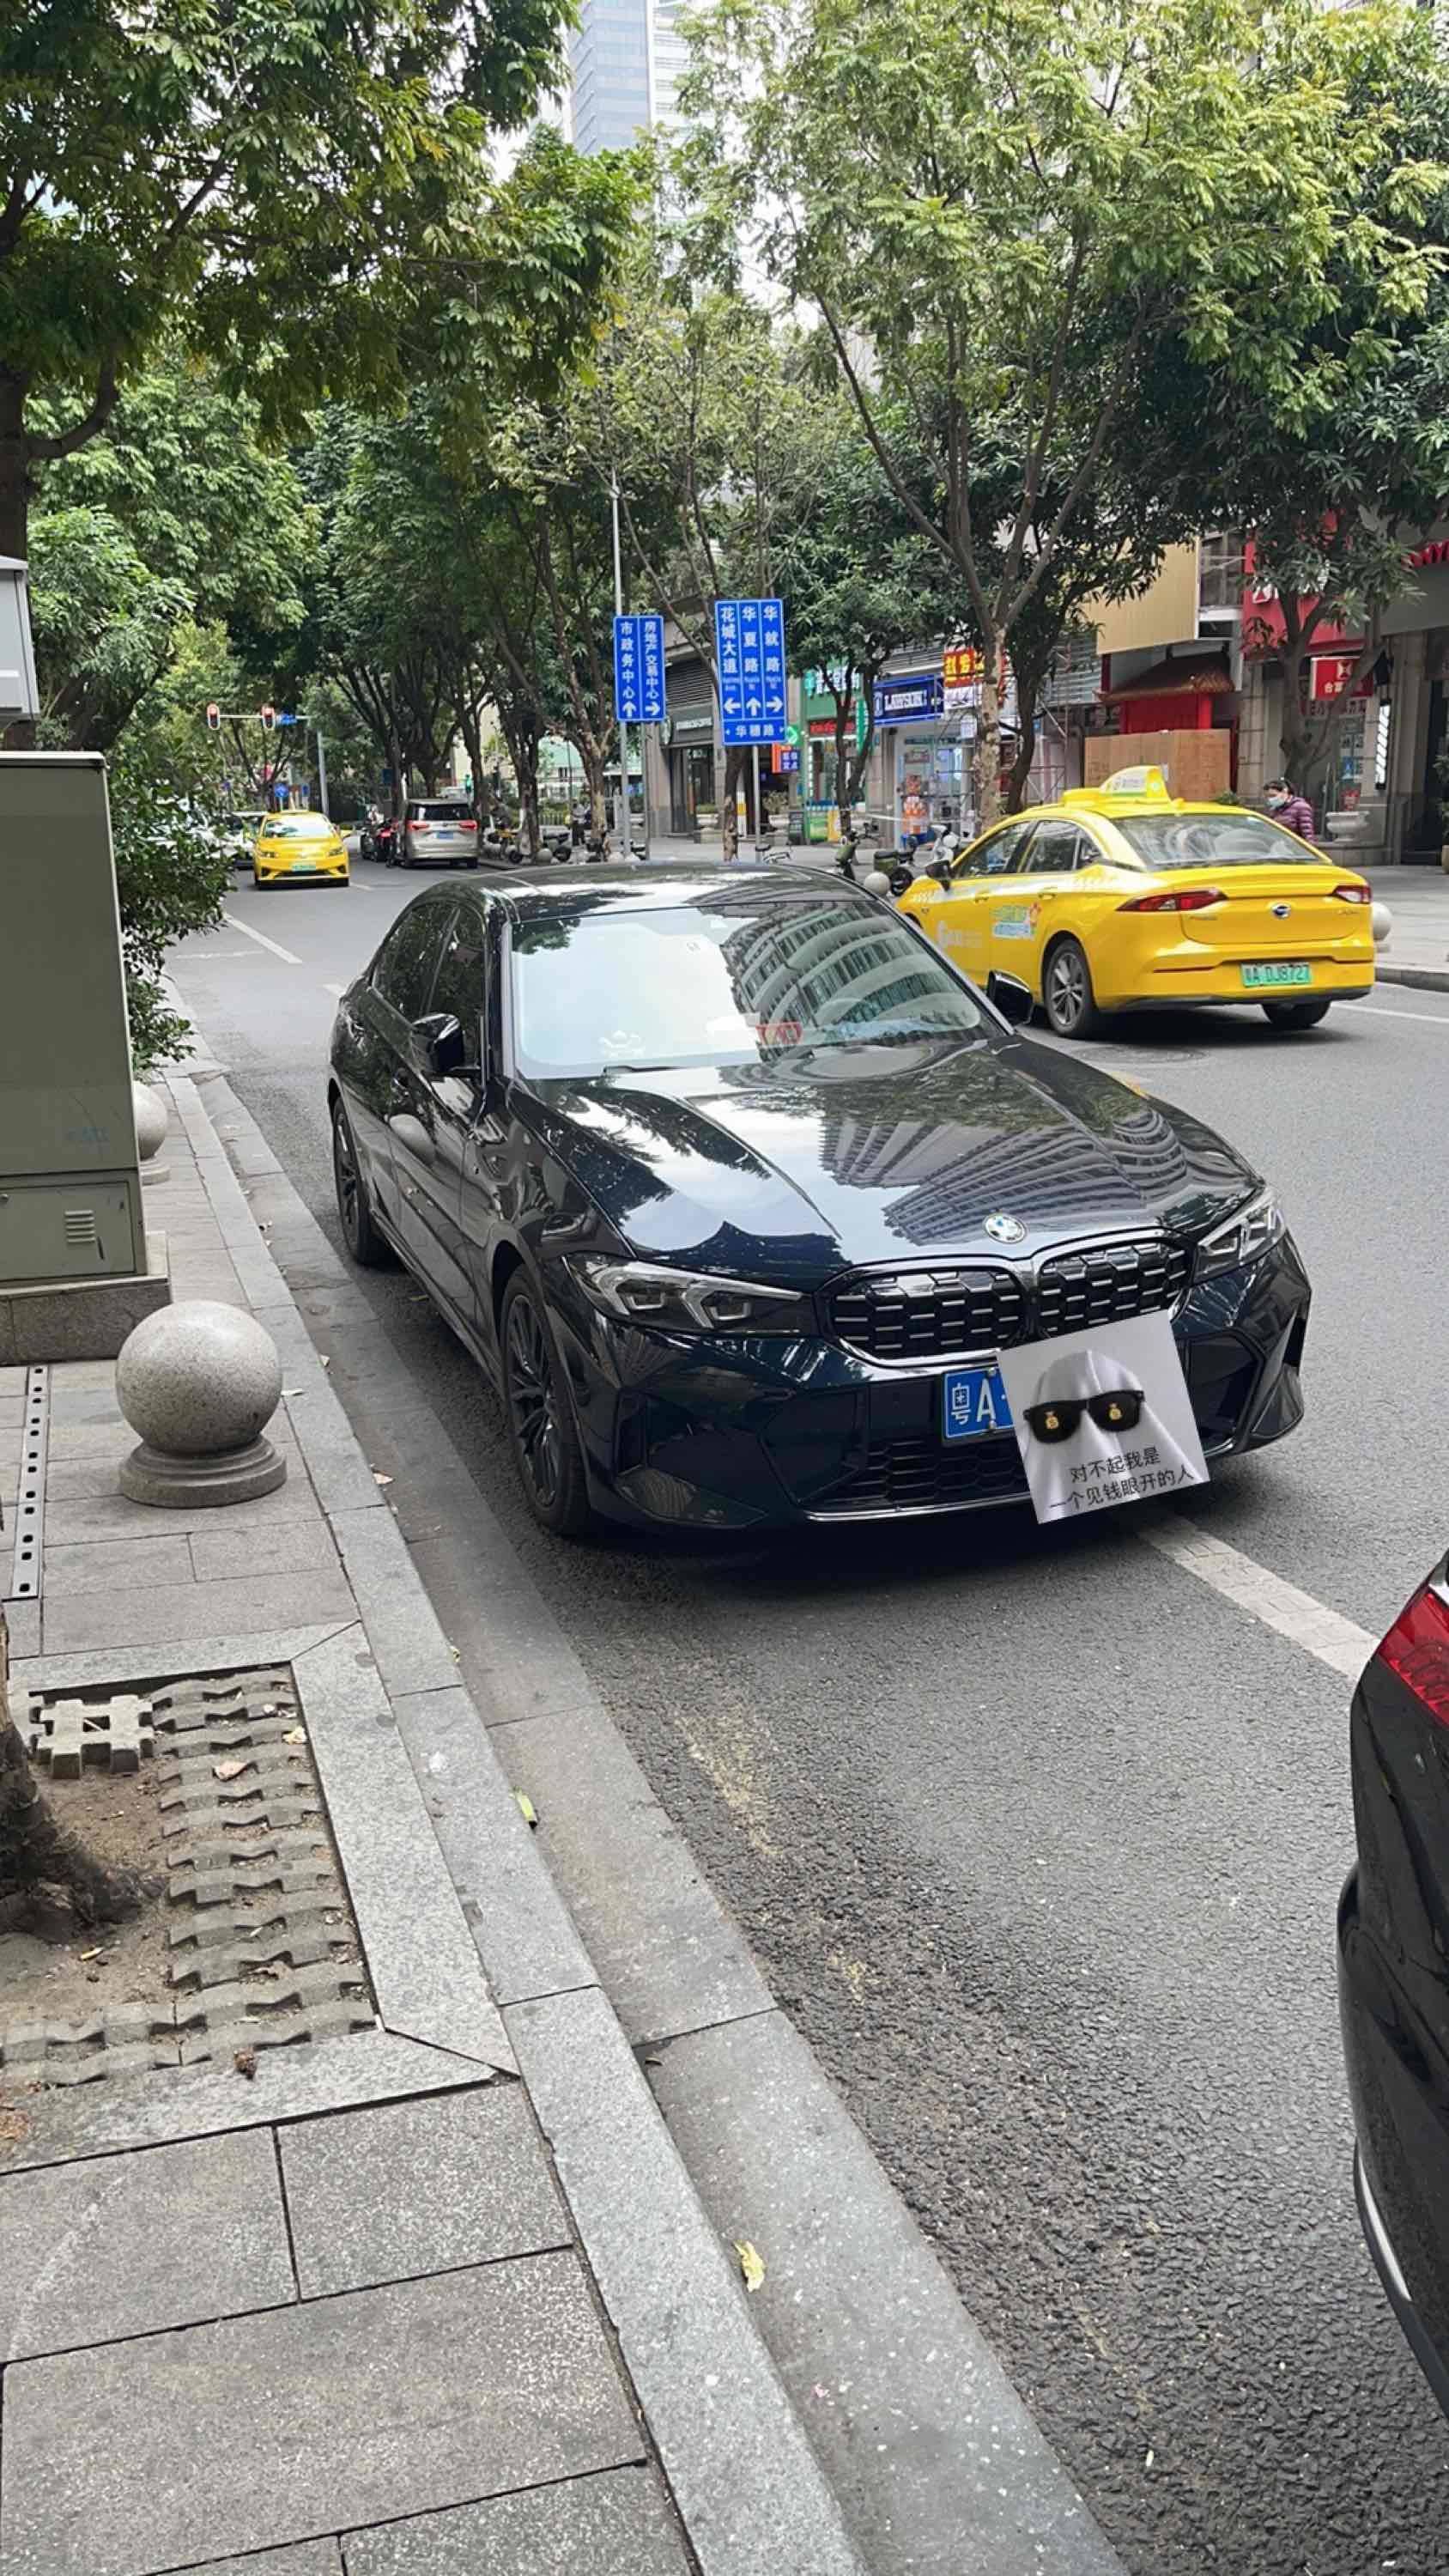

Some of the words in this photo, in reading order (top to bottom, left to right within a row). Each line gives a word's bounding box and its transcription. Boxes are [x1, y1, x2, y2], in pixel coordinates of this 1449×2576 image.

[620, 622, 635, 700] 市政务中心
[720, 605, 737, 674] 花城大道
[742, 605, 759, 673] 华夏路
[1049, 1465, 1195, 1511] 一个见钱眼开的人
[1070, 1445, 1162, 1485] 对不起我是
